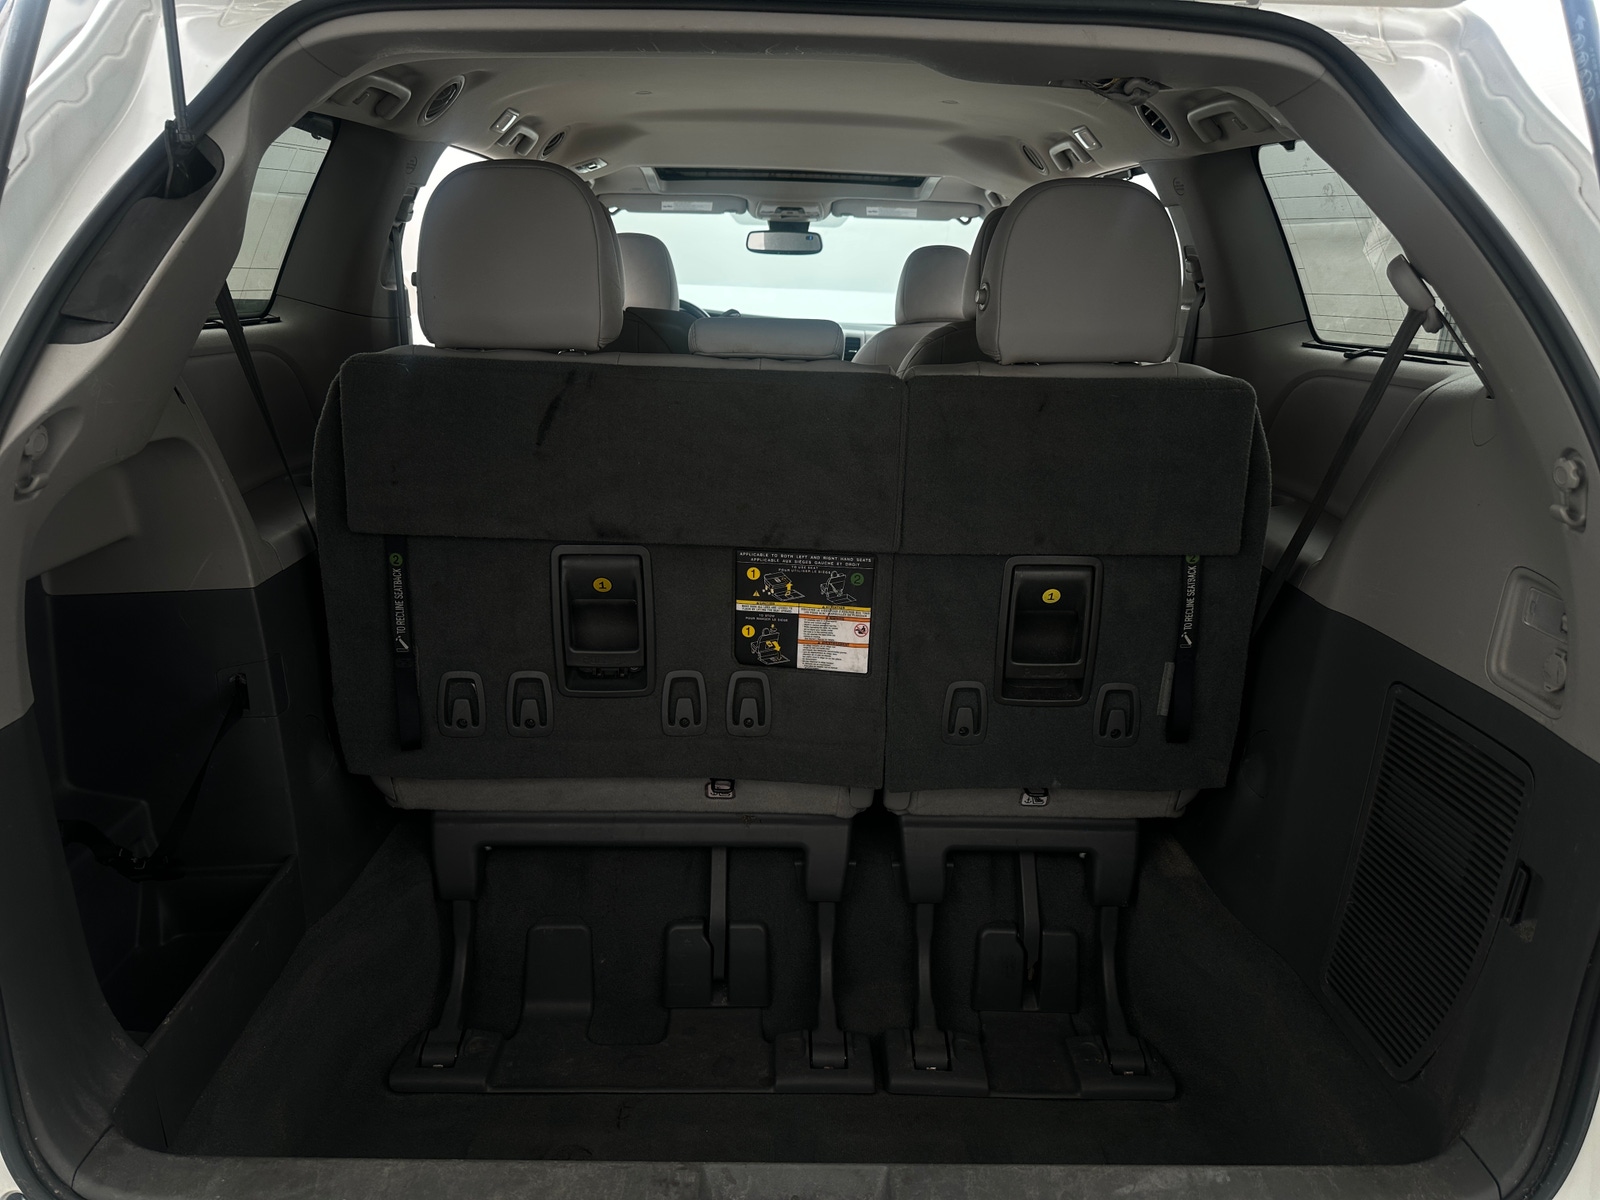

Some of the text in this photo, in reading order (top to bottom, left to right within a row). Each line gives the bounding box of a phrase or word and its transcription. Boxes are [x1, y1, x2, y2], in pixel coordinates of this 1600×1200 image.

[392, 555, 400, 564] 2
[854, 574, 860, 584] 2
[1183, 565, 1197, 630] TO RECLINE SEATBACK
[392, 568, 406, 634] TO RECLINE SEATBACK
